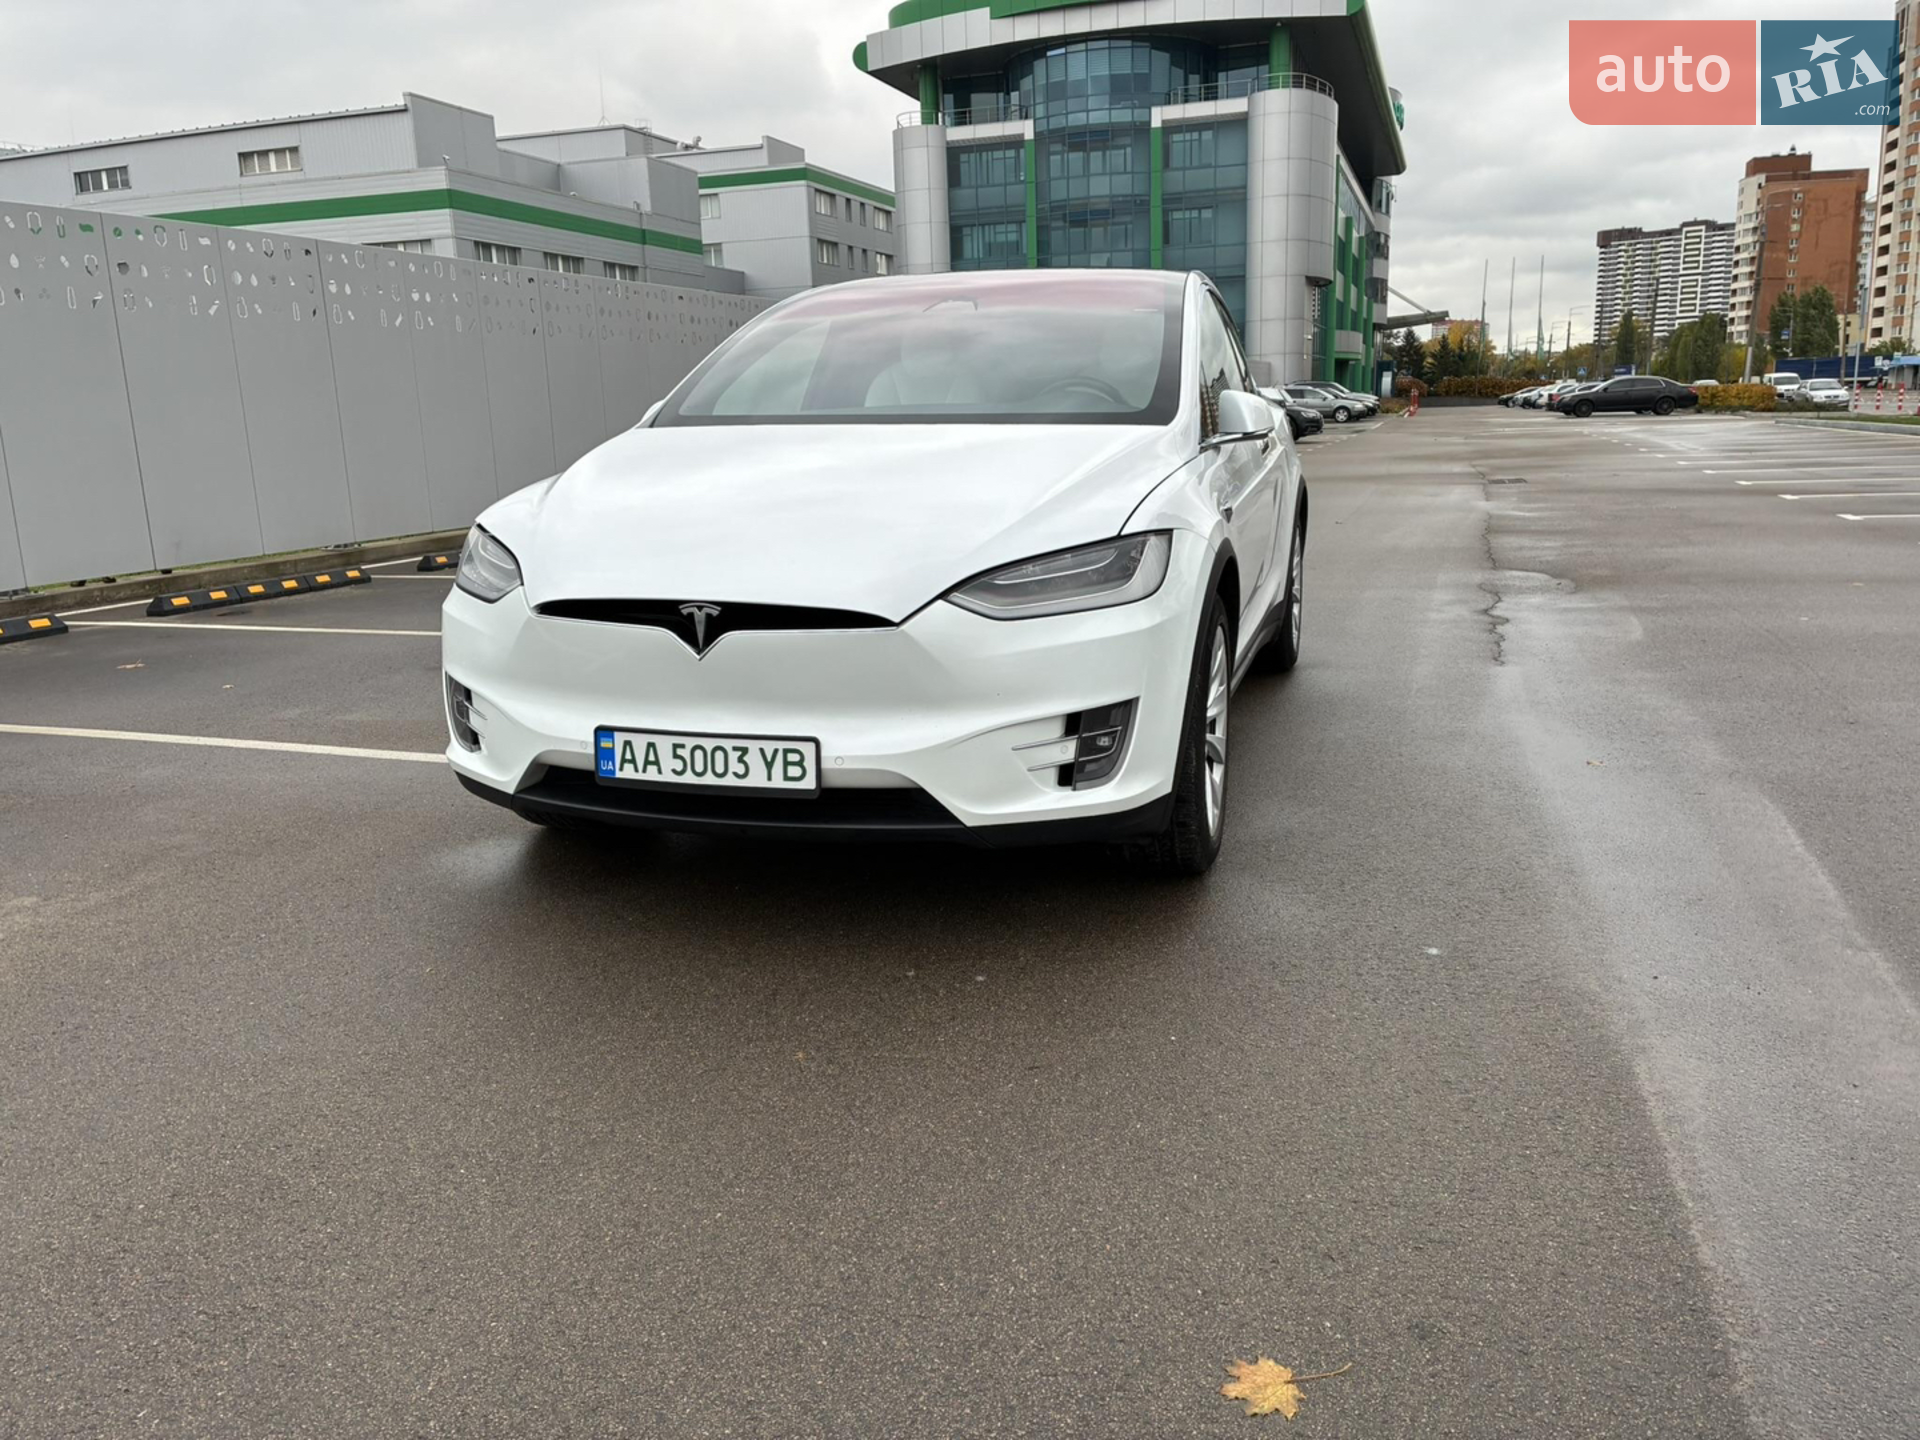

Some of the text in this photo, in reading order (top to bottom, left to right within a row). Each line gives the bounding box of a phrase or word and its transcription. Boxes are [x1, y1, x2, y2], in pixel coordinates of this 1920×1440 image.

[600, 760, 615, 771] UA
[618, 739, 808, 782] AA 5003 YB
